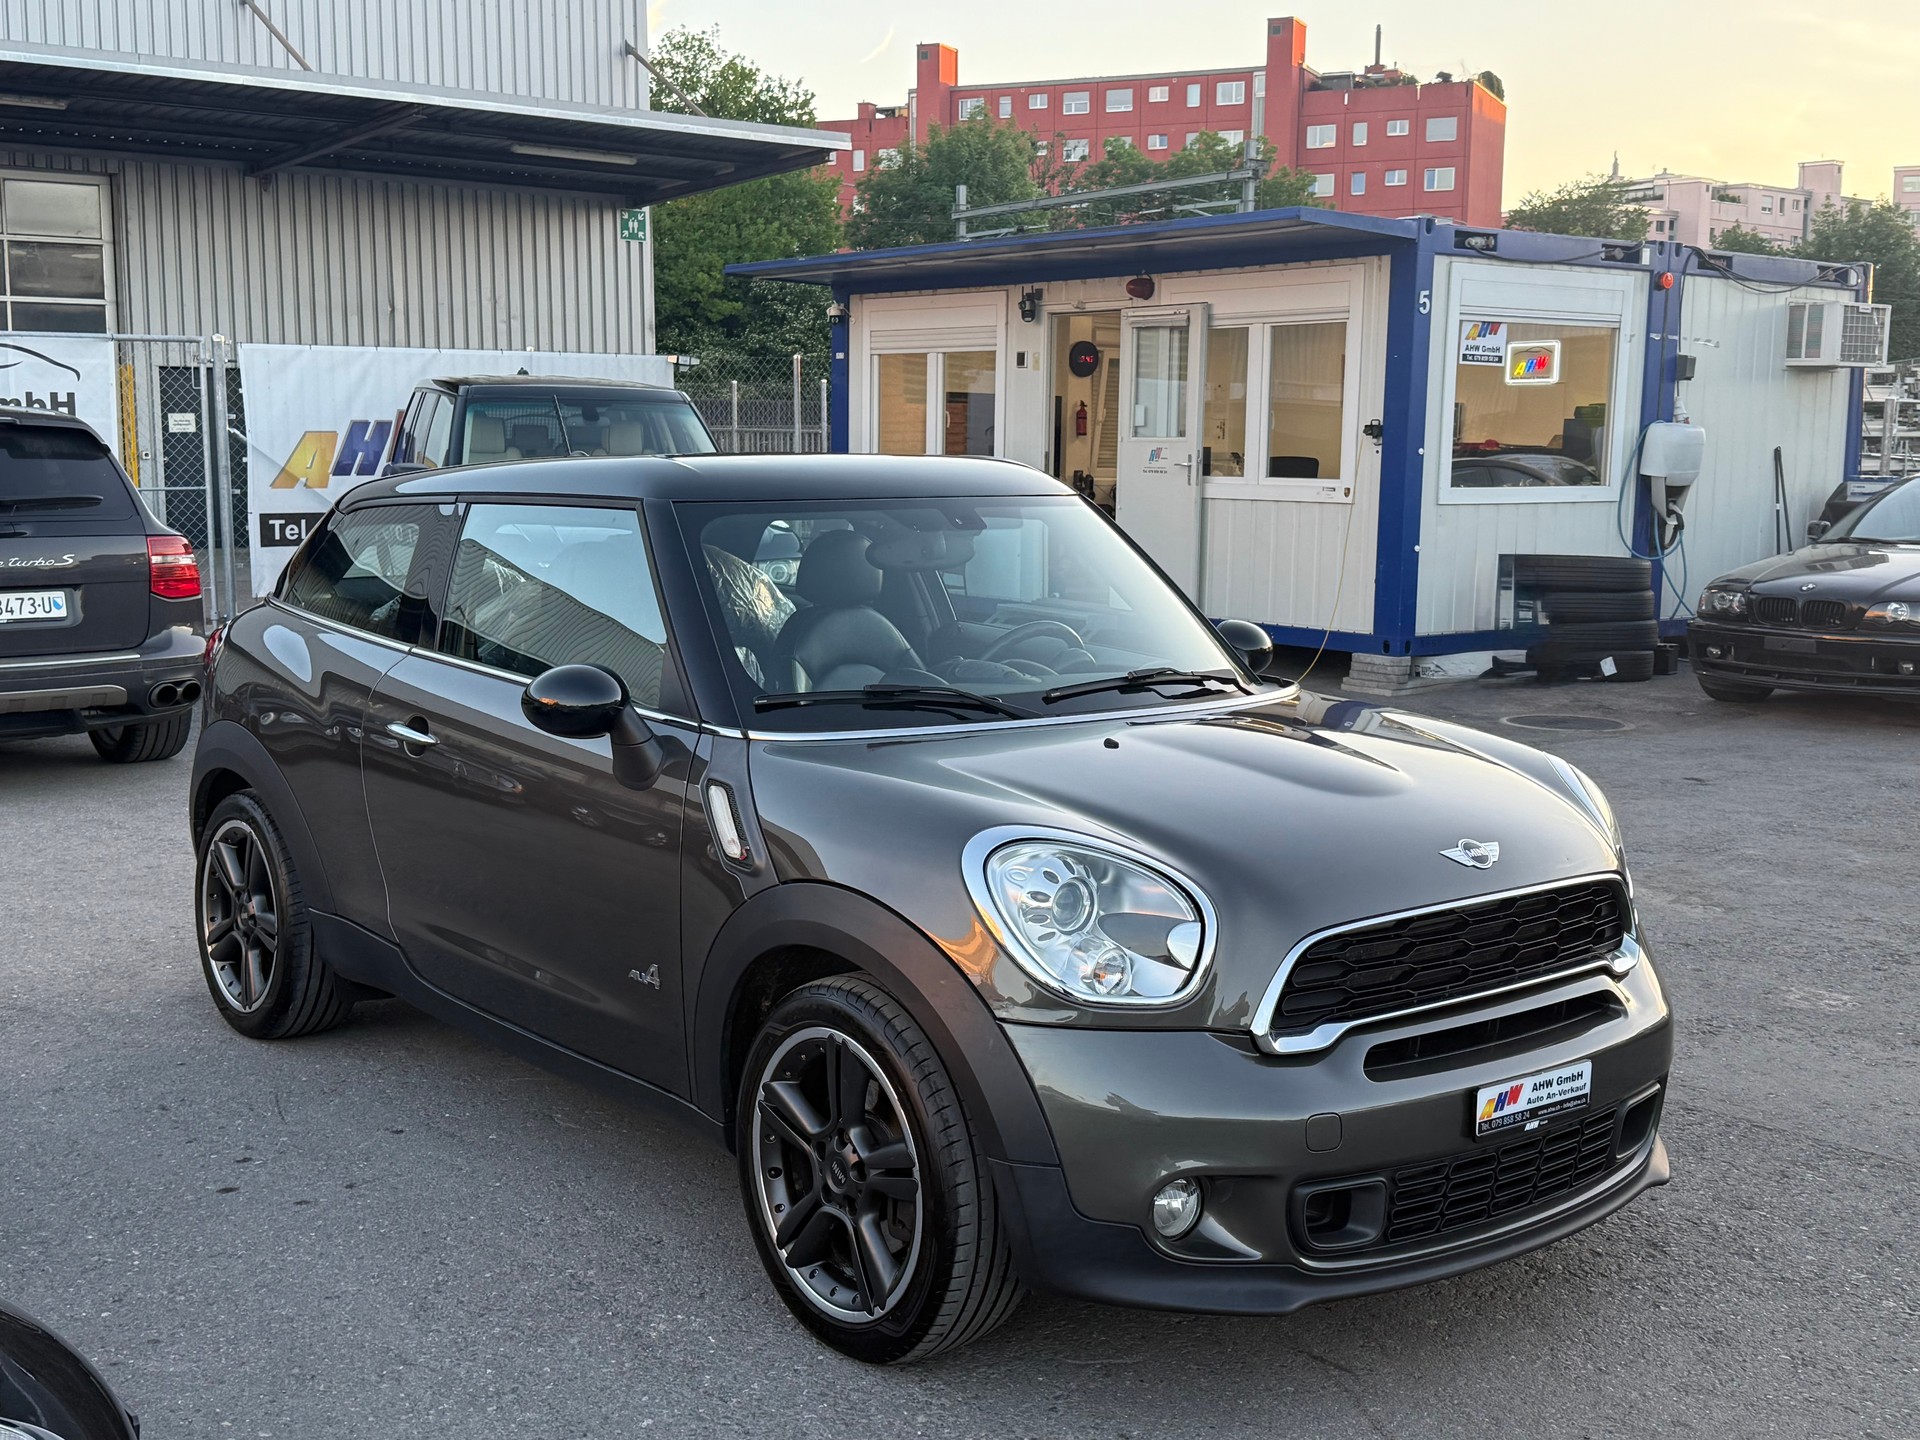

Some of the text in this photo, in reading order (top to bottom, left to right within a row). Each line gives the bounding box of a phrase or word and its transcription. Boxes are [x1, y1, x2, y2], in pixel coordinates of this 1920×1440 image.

[1419, 289, 1431, 315] 5
[1465, 321, 1502, 340] AHW
[1465, 344, 1501, 353] AHW GmbH
[1513, 354, 1549, 377] AHW
[269, 409, 406, 489] AH
[8, 557, 55, 567] turbo
[54, 553, 76, 566] S
[1531, 1070, 1583, 1093] AHW GmbH
[1479, 1083, 1524, 1121] AHW
[1527, 1082, 1587, 1106] Auto An-Verkauf
[1481, 1121, 1490, 1131] Tel.
[1491, 1118, 1502, 1128] 079
[1523, 1110, 1530, 1120] 24
[831, 1160, 846, 1184] MINI
